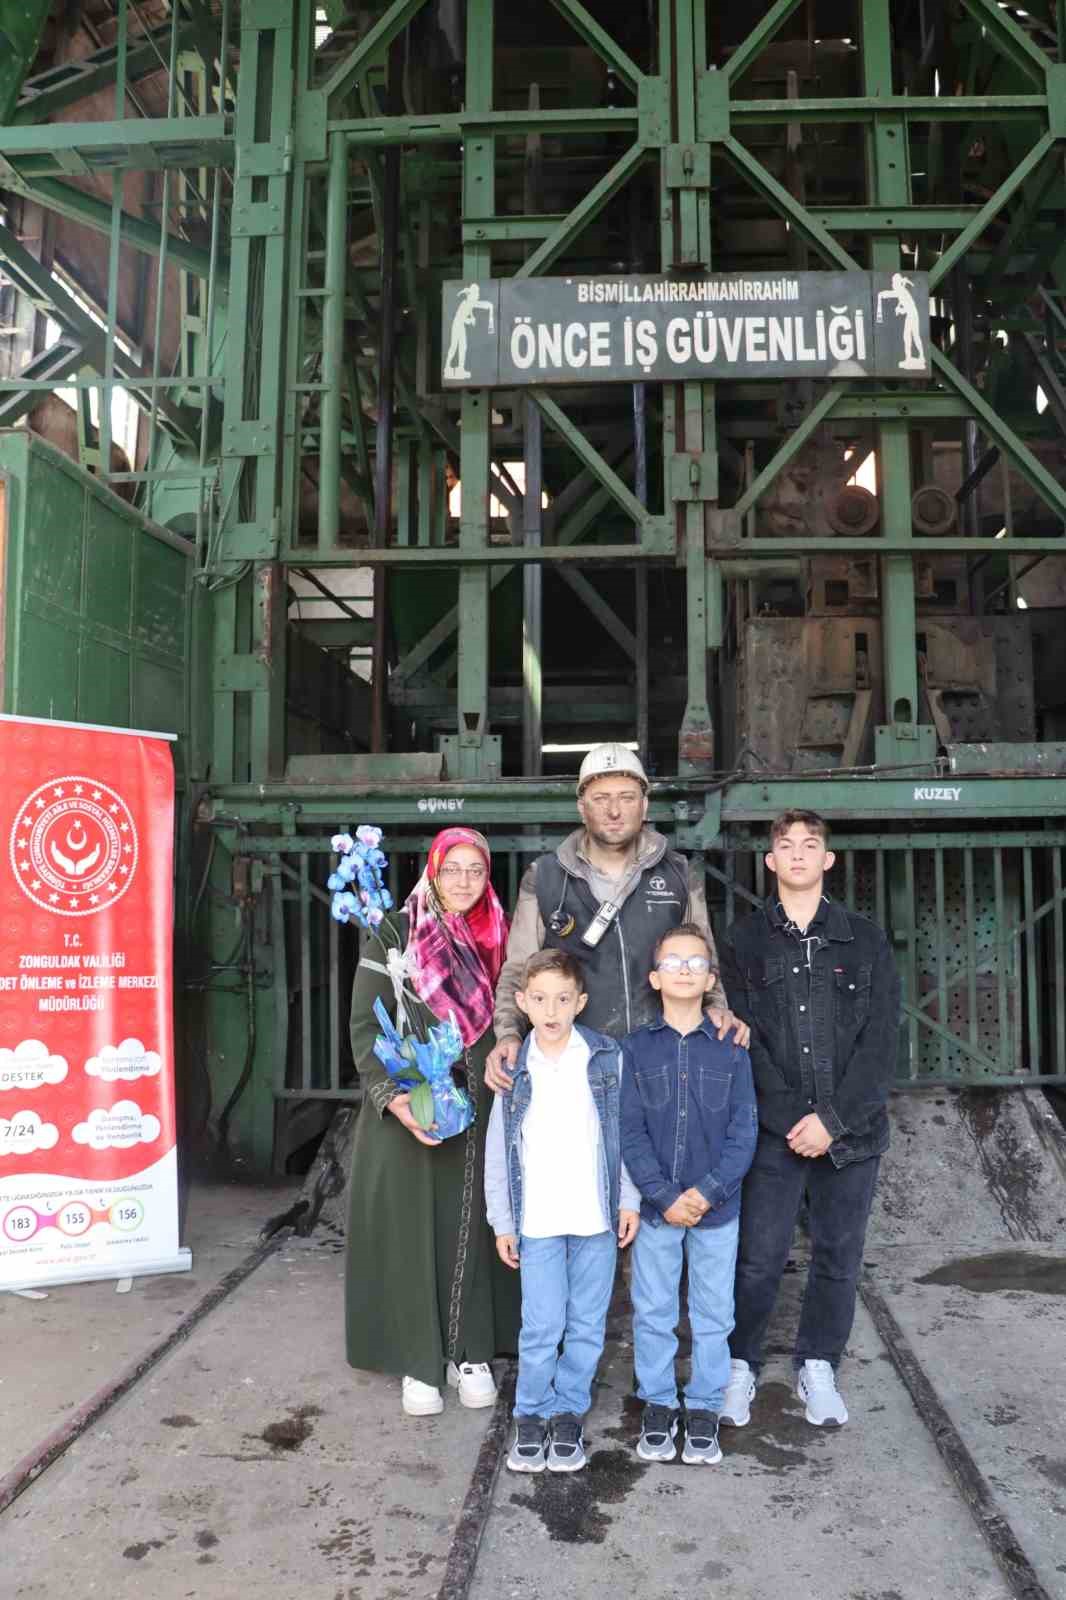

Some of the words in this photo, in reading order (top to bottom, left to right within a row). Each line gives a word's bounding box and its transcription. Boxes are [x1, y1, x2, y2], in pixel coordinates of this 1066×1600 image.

[511, 317, 611, 369] ÖNCE
[624, 315, 658, 372] İŞ
[666, 305, 866, 363] GÜVENLİĞİ
[914, 786, 962, 801] KUZEY
[63, 933, 83, 948] T.C.
[19, 955, 81, 969] ZONGULDAK
[83, 952, 125, 968] VALİLİĞİ
[20, 974, 63, 990] ÖNLEME
[65, 978, 77, 989] ve
[79, 973, 115, 989] İZLEME
[38, 995, 105, 1012] MÜDÜRLÜĞÜ
[1, 1071, 44, 1083] DESTEK
[4, 1124, 35, 1137] 7/24
[66, 1213, 85, 1225] 155
[119, 1208, 137, 1220] 156
[11, 1217, 31, 1230] 183
